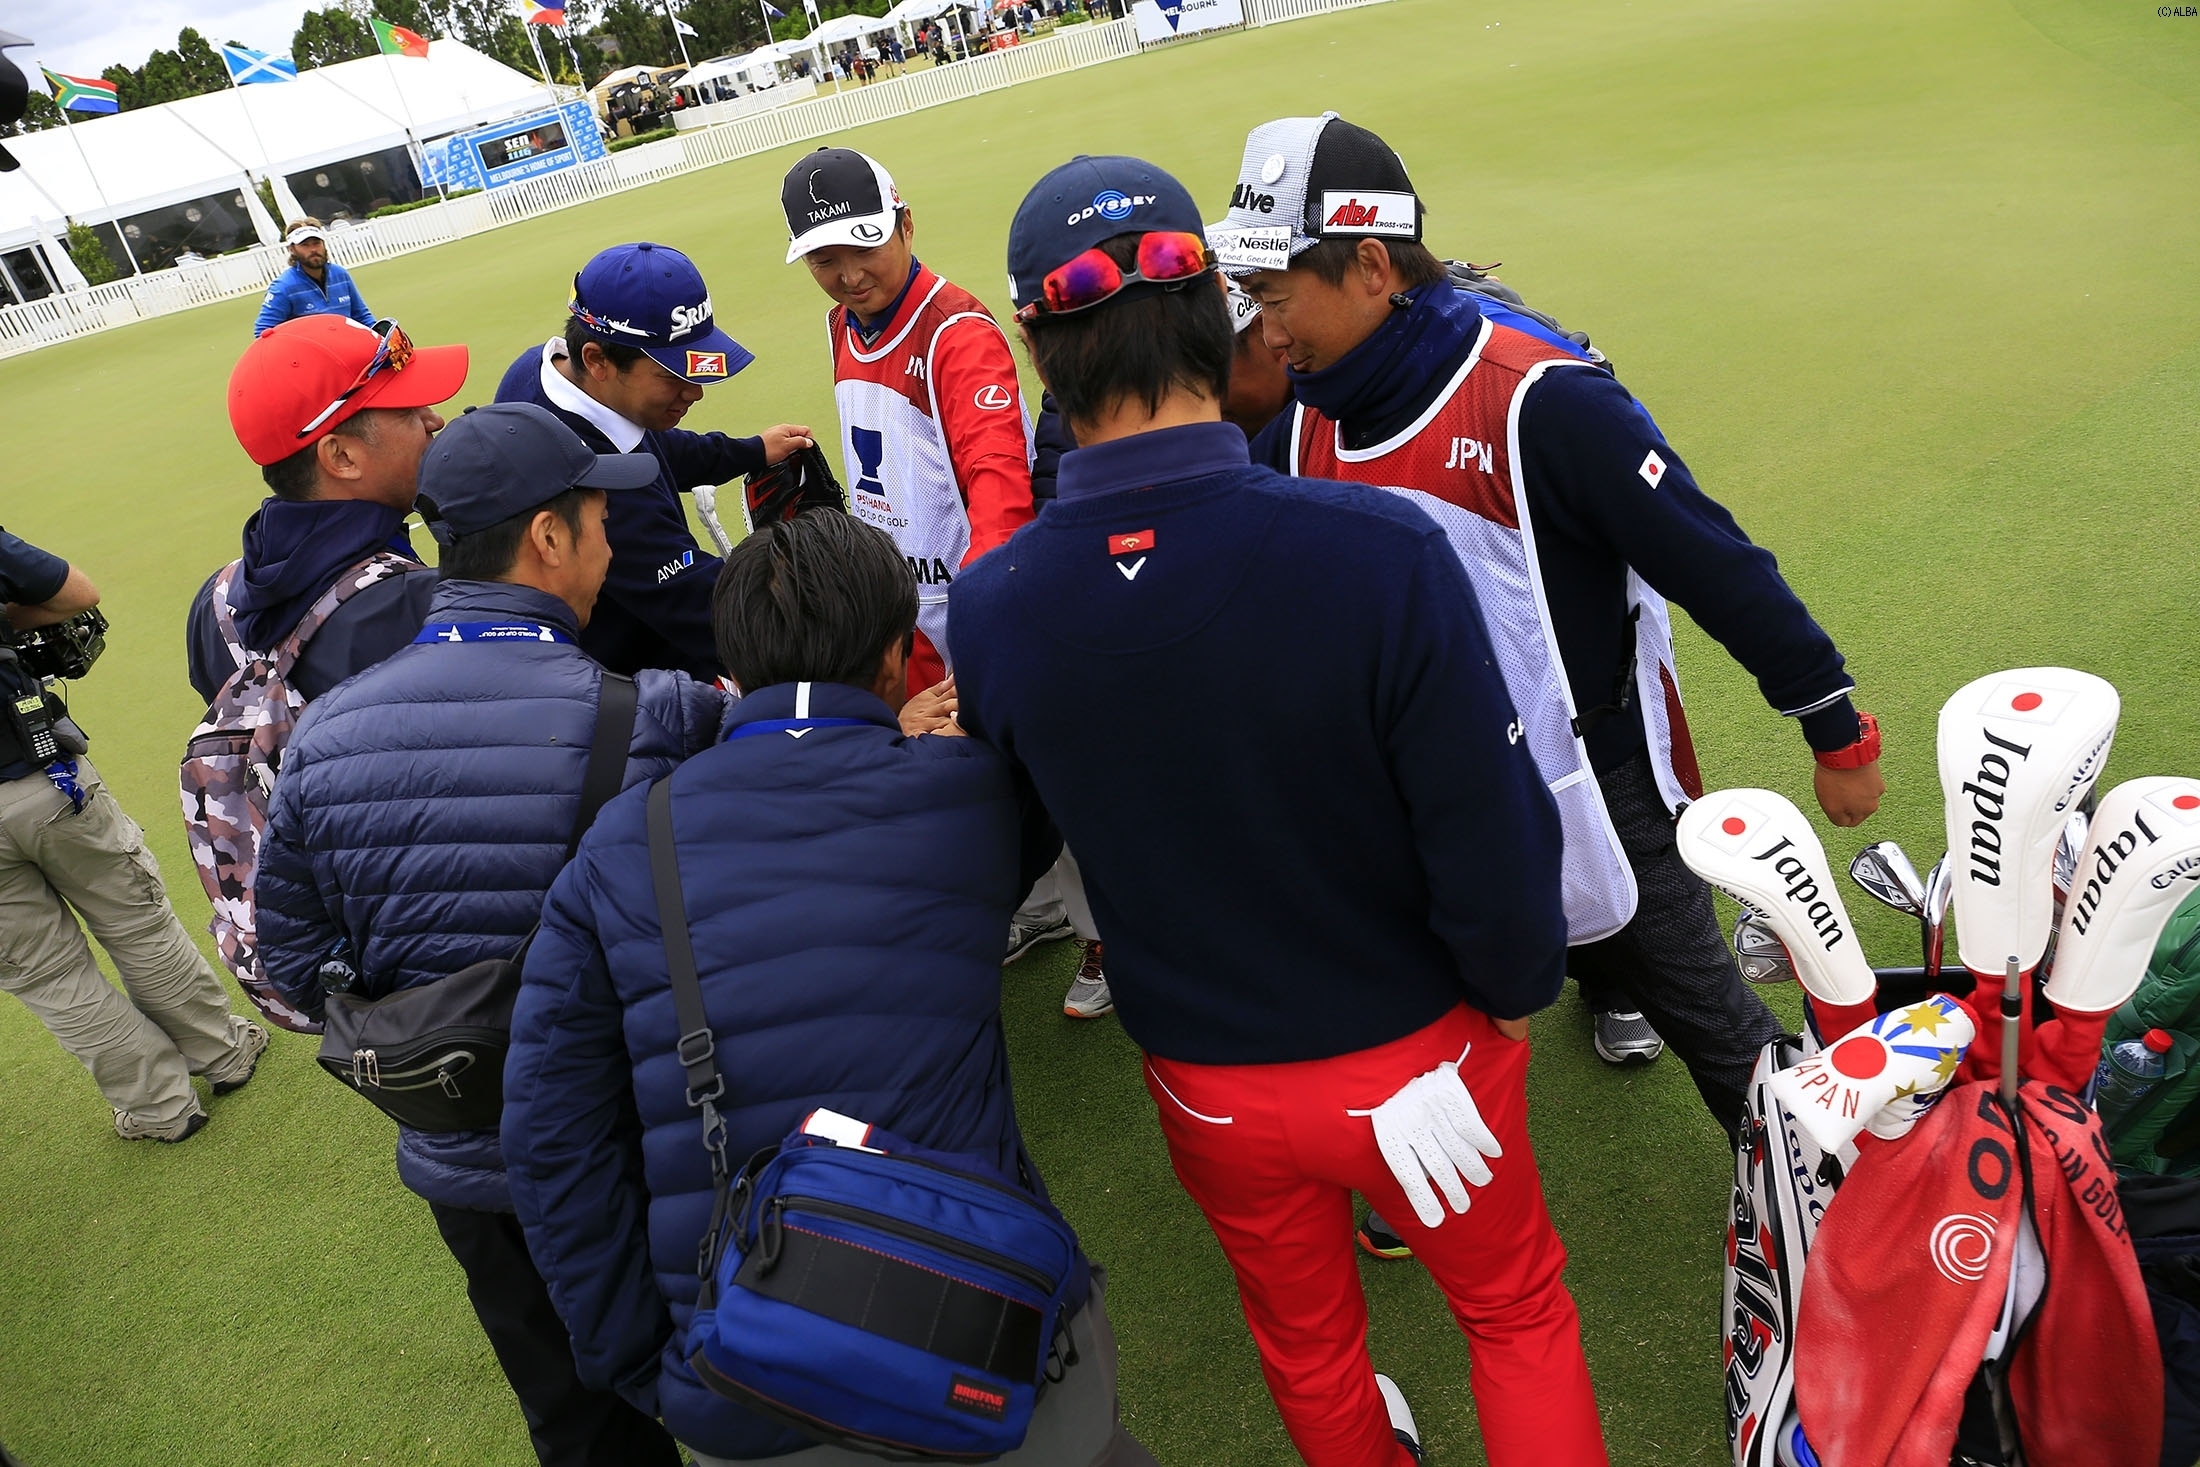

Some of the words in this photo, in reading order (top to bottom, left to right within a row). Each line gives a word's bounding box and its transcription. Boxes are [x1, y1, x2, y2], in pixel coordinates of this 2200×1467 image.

[504, 134, 530, 151] SEN
[489, 166, 531, 184] MELBOURNE'S
[530, 159, 547, 174] HOME
[547, 156, 556, 167] OF
[555, 150, 573, 165] SPORT
[807, 200, 851, 223] TAKAMI
[1067, 195, 1157, 226] ODYSSEY
[1325, 199, 1379, 227] ALBA
[694, 365, 719, 373] STAR
[1444, 436, 1494, 474] JPN
[886, 515, 909, 529] GOLF
[657, 558, 685, 584] ANA
[1961, 726, 2033, 888] Japan
[2070, 808, 2163, 936] Japan
[1750, 834, 1845, 952] Japan
[2058, 1147, 2090, 1183] IN
[953, 1383, 1005, 1407] BRIEFING
